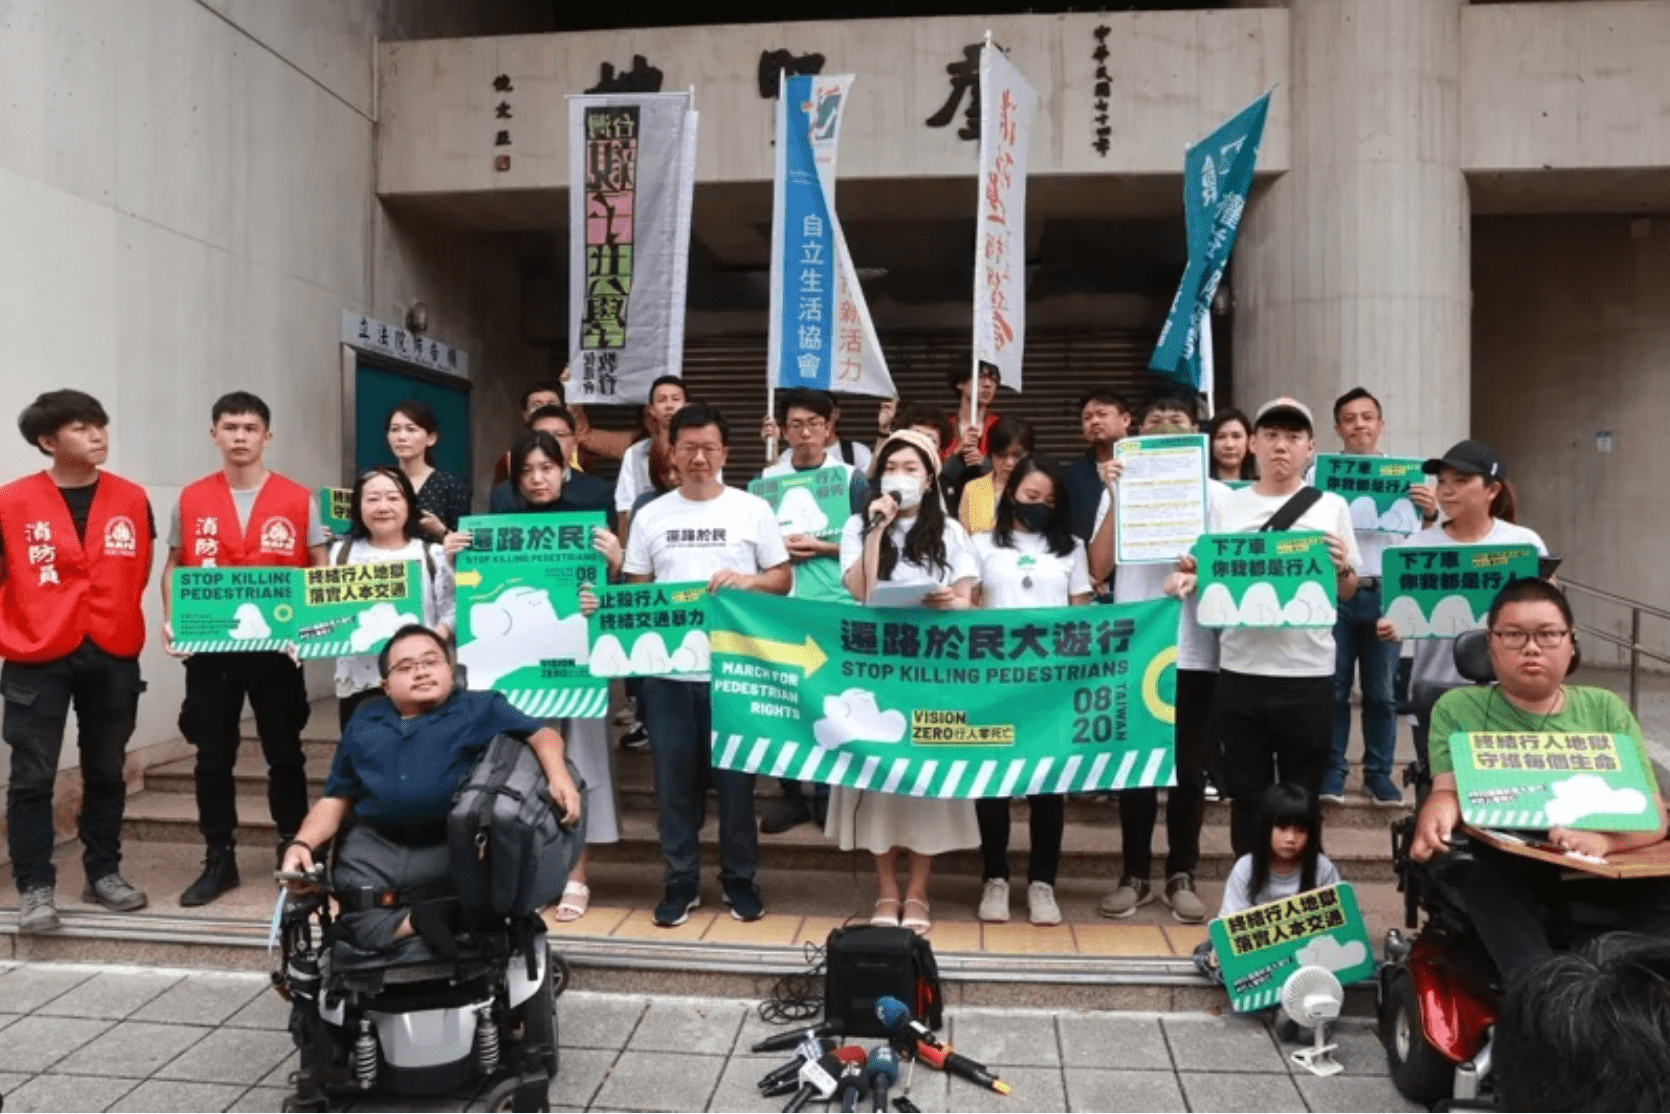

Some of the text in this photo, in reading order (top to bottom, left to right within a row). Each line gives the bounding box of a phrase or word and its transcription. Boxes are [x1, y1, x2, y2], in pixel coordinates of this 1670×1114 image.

[797, 213, 824, 378] 自立生活協會
[1328, 458, 1372, 475] 下了車
[468, 525, 599, 551] 還路於民
[666, 528, 727, 542] 還路於民
[24, 520, 60, 586] 消防員
[1210, 537, 1265, 555] 下了車
[1211, 558, 1322, 577] 你我都是行人
[1399, 551, 1459, 570] 下了車
[180, 572, 223, 586] STOP
[308, 563, 405, 585] 終結行人地獄
[600, 588, 669, 609] 止殺行人
[600, 609, 704, 630] 終結交通暴力
[841, 618, 1135, 661] 還路於民大遊行
[722, 661, 798, 687] MARCH FOR
[841, 660, 1128, 684] STOP KILLING PEDESTRIANS
[714, 679, 798, 703] PEDESTRIAN
[1073, 686, 1113, 715] 08
[750, 701, 800, 720] RIGHTS
[913, 710, 966, 724] VISION
[1115, 682, 1127, 742] TAIWAN
[913, 727, 953, 740] ZERO
[1072, 715, 1113, 744] 20
[1473, 735, 1611, 750] 終結行人地獄
[1477, 753, 1618, 770] 守護每個生命
[1229, 888, 1338, 932] 終結行人地獄
[1233, 909, 1344, 953] 落實人本交通
